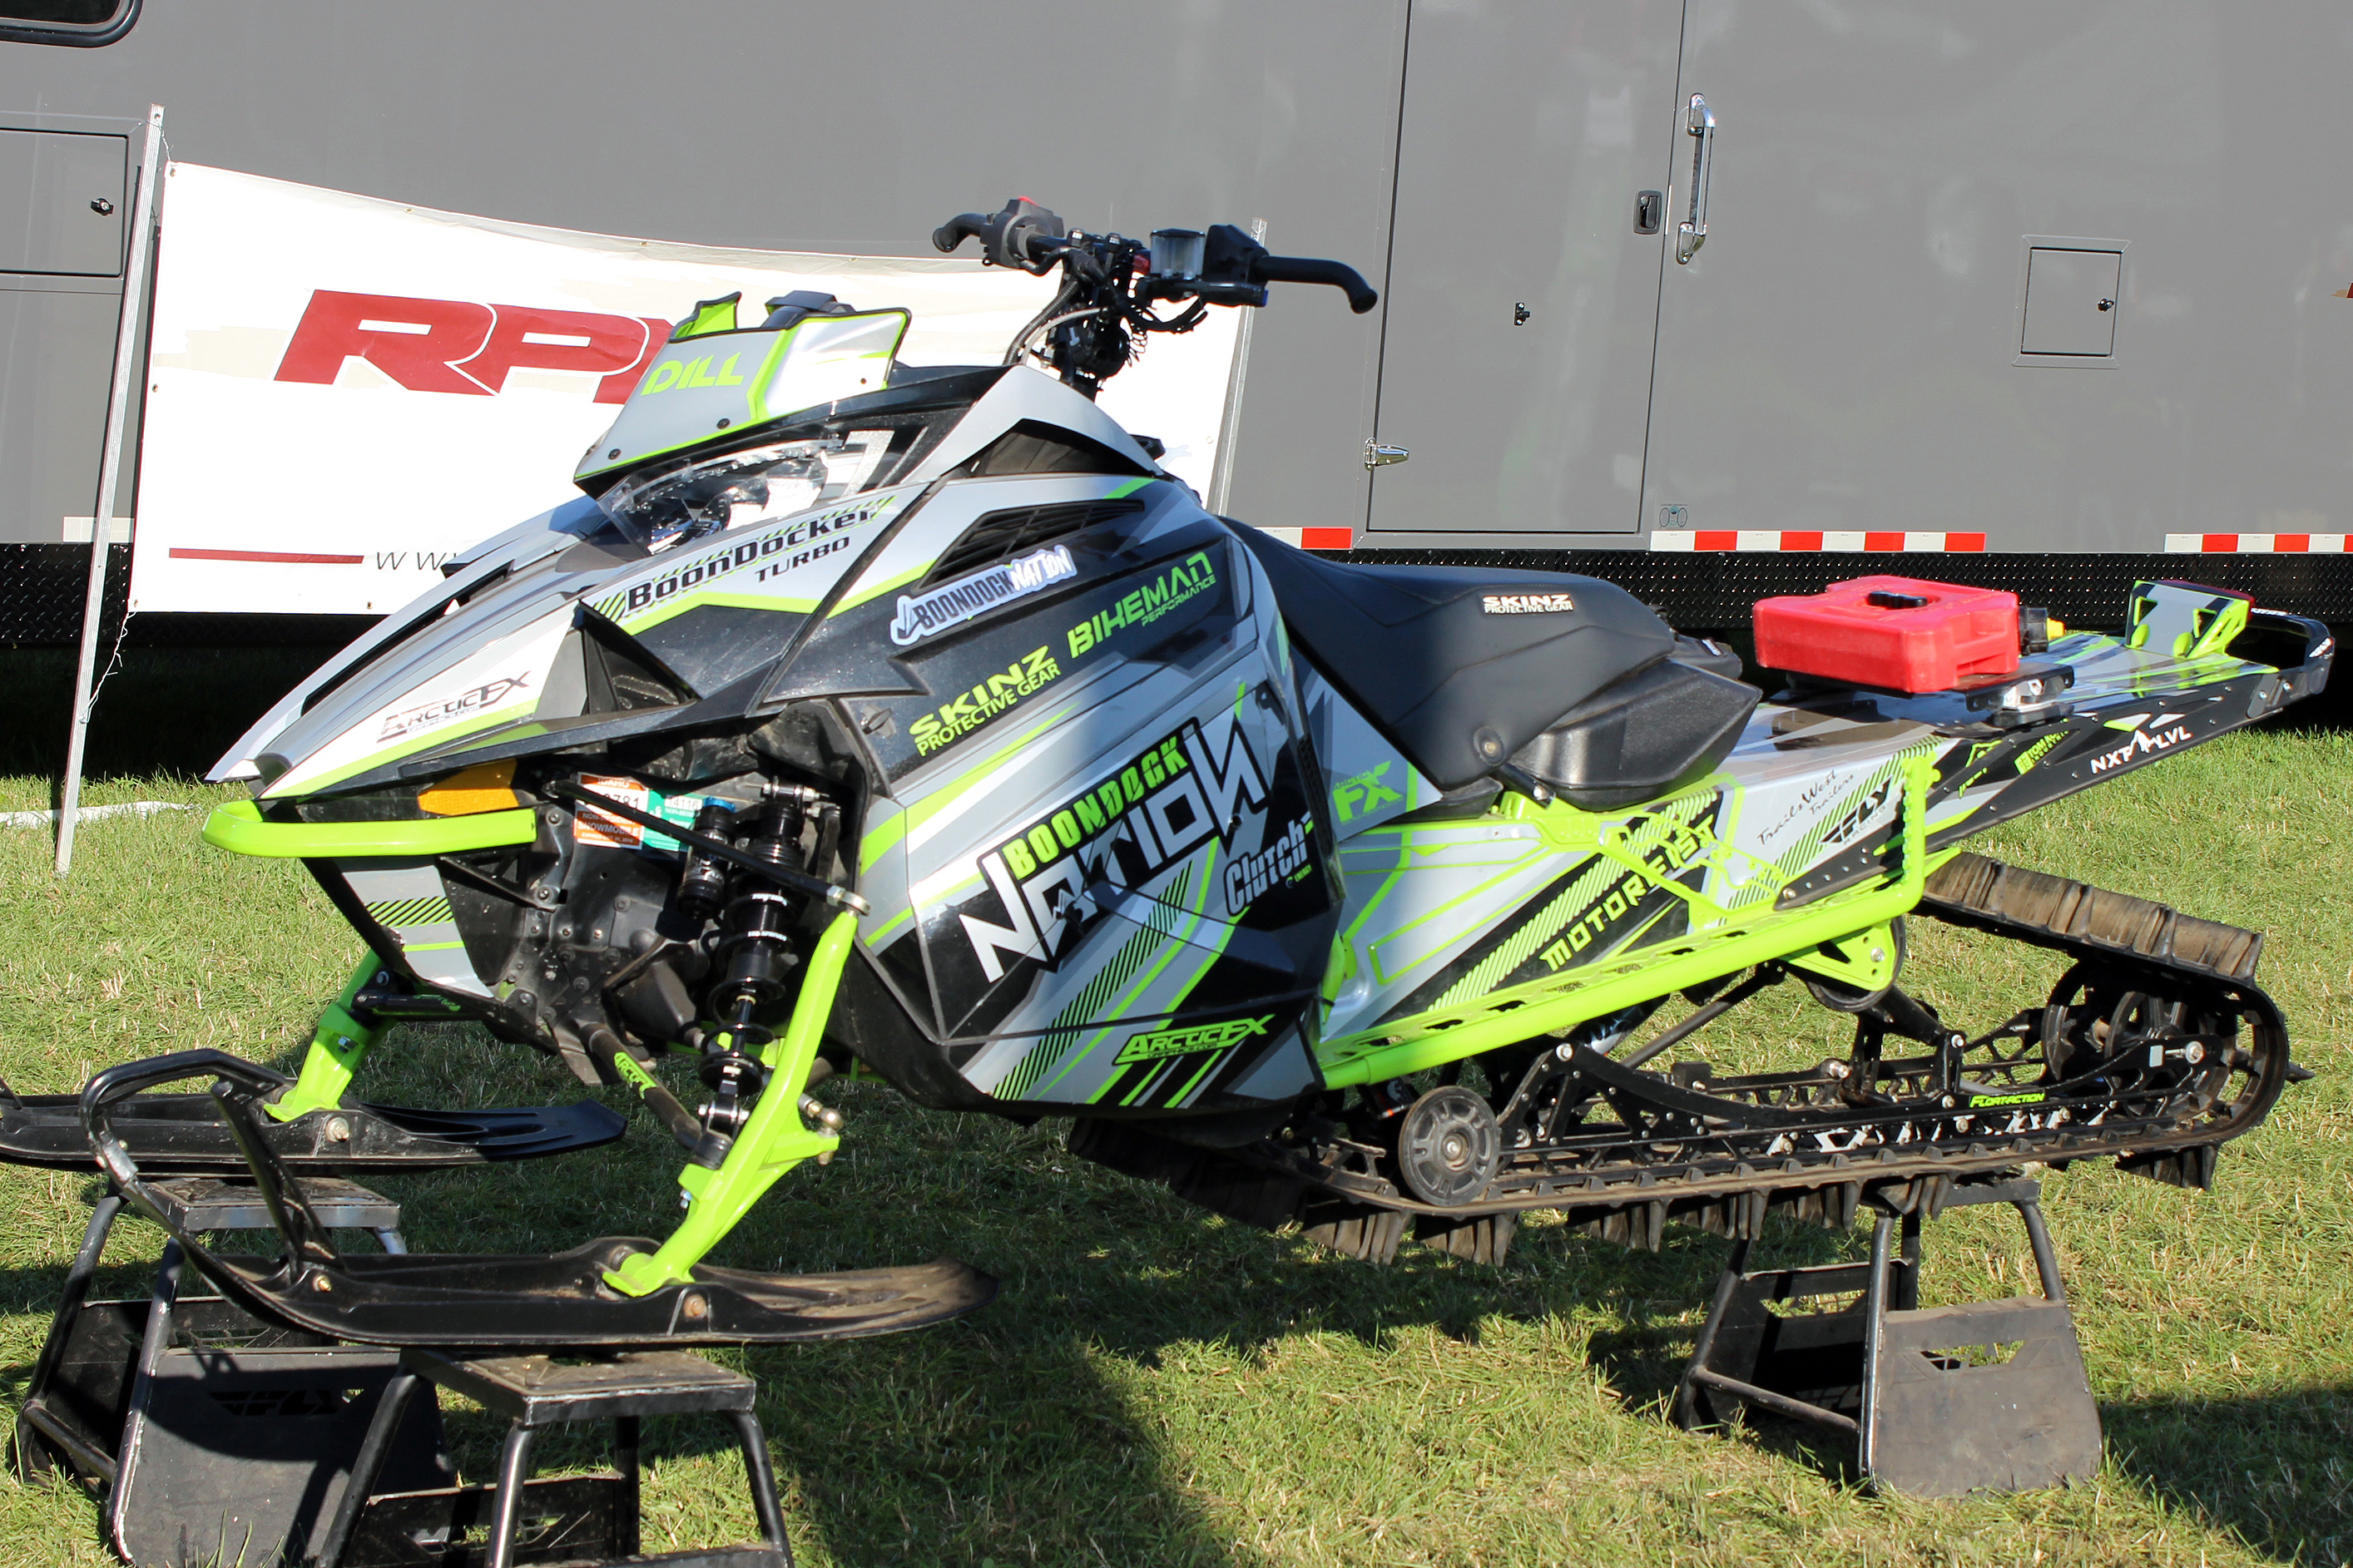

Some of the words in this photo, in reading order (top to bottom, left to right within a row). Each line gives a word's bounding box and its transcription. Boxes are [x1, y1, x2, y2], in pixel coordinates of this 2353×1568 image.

[640, 351, 745, 396] DILL
[755, 536, 851, 584] TURBO
[1067, 551, 1214, 659] BIKEMAN
[1140, 573, 1216, 627] PERFORMANCE
[1482, 593, 1573, 606] SKINZ
[1484, 605, 1545, 615] PROTECTIVE
[1544, 603, 1574, 613] GEAR
[909, 644, 1056, 744] SKINZ
[915, 688, 1019, 758] PROTECTIVE
[1015, 662, 1062, 697] GEAR
[2153, 725, 2193, 750] LVL
[577, 821, 639, 836] SNOWMOBILE
[1001, 735, 1189, 881] BOONDOCK
[1819, 775, 1893, 843] FLY
[1843, 804, 1887, 846] RACING
